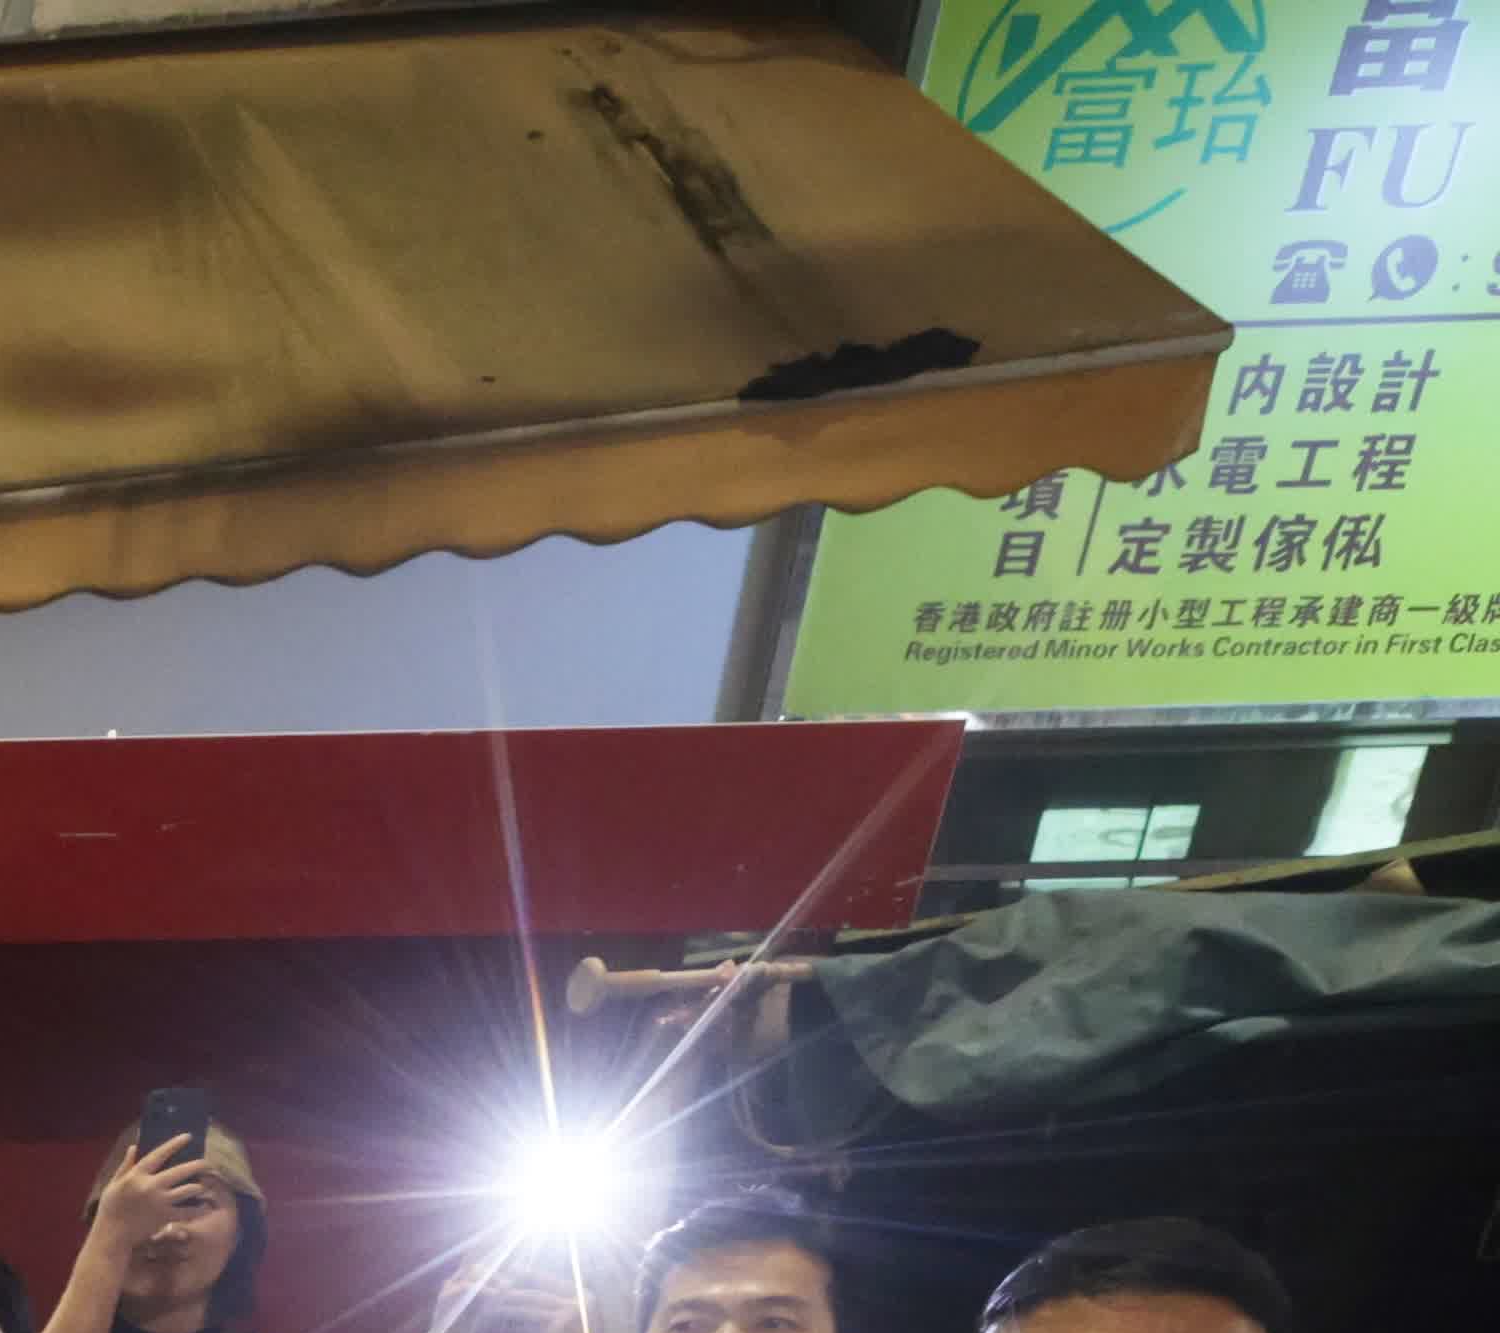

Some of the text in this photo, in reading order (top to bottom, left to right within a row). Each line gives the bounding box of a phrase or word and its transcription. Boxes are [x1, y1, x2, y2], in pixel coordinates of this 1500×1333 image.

[1284, 121, 1477, 214] FU
[1108, 514, 1387, 575] 定製傢俬
[903, 640, 1041, 666] Registered
[1044, 636, 1119, 660] Minor
[1127, 636, 1205, 658] Works
[1212, 634, 1352, 657] Contractor
[1354, 633, 1380, 655] in
[1384, 633, 1442, 654] First
